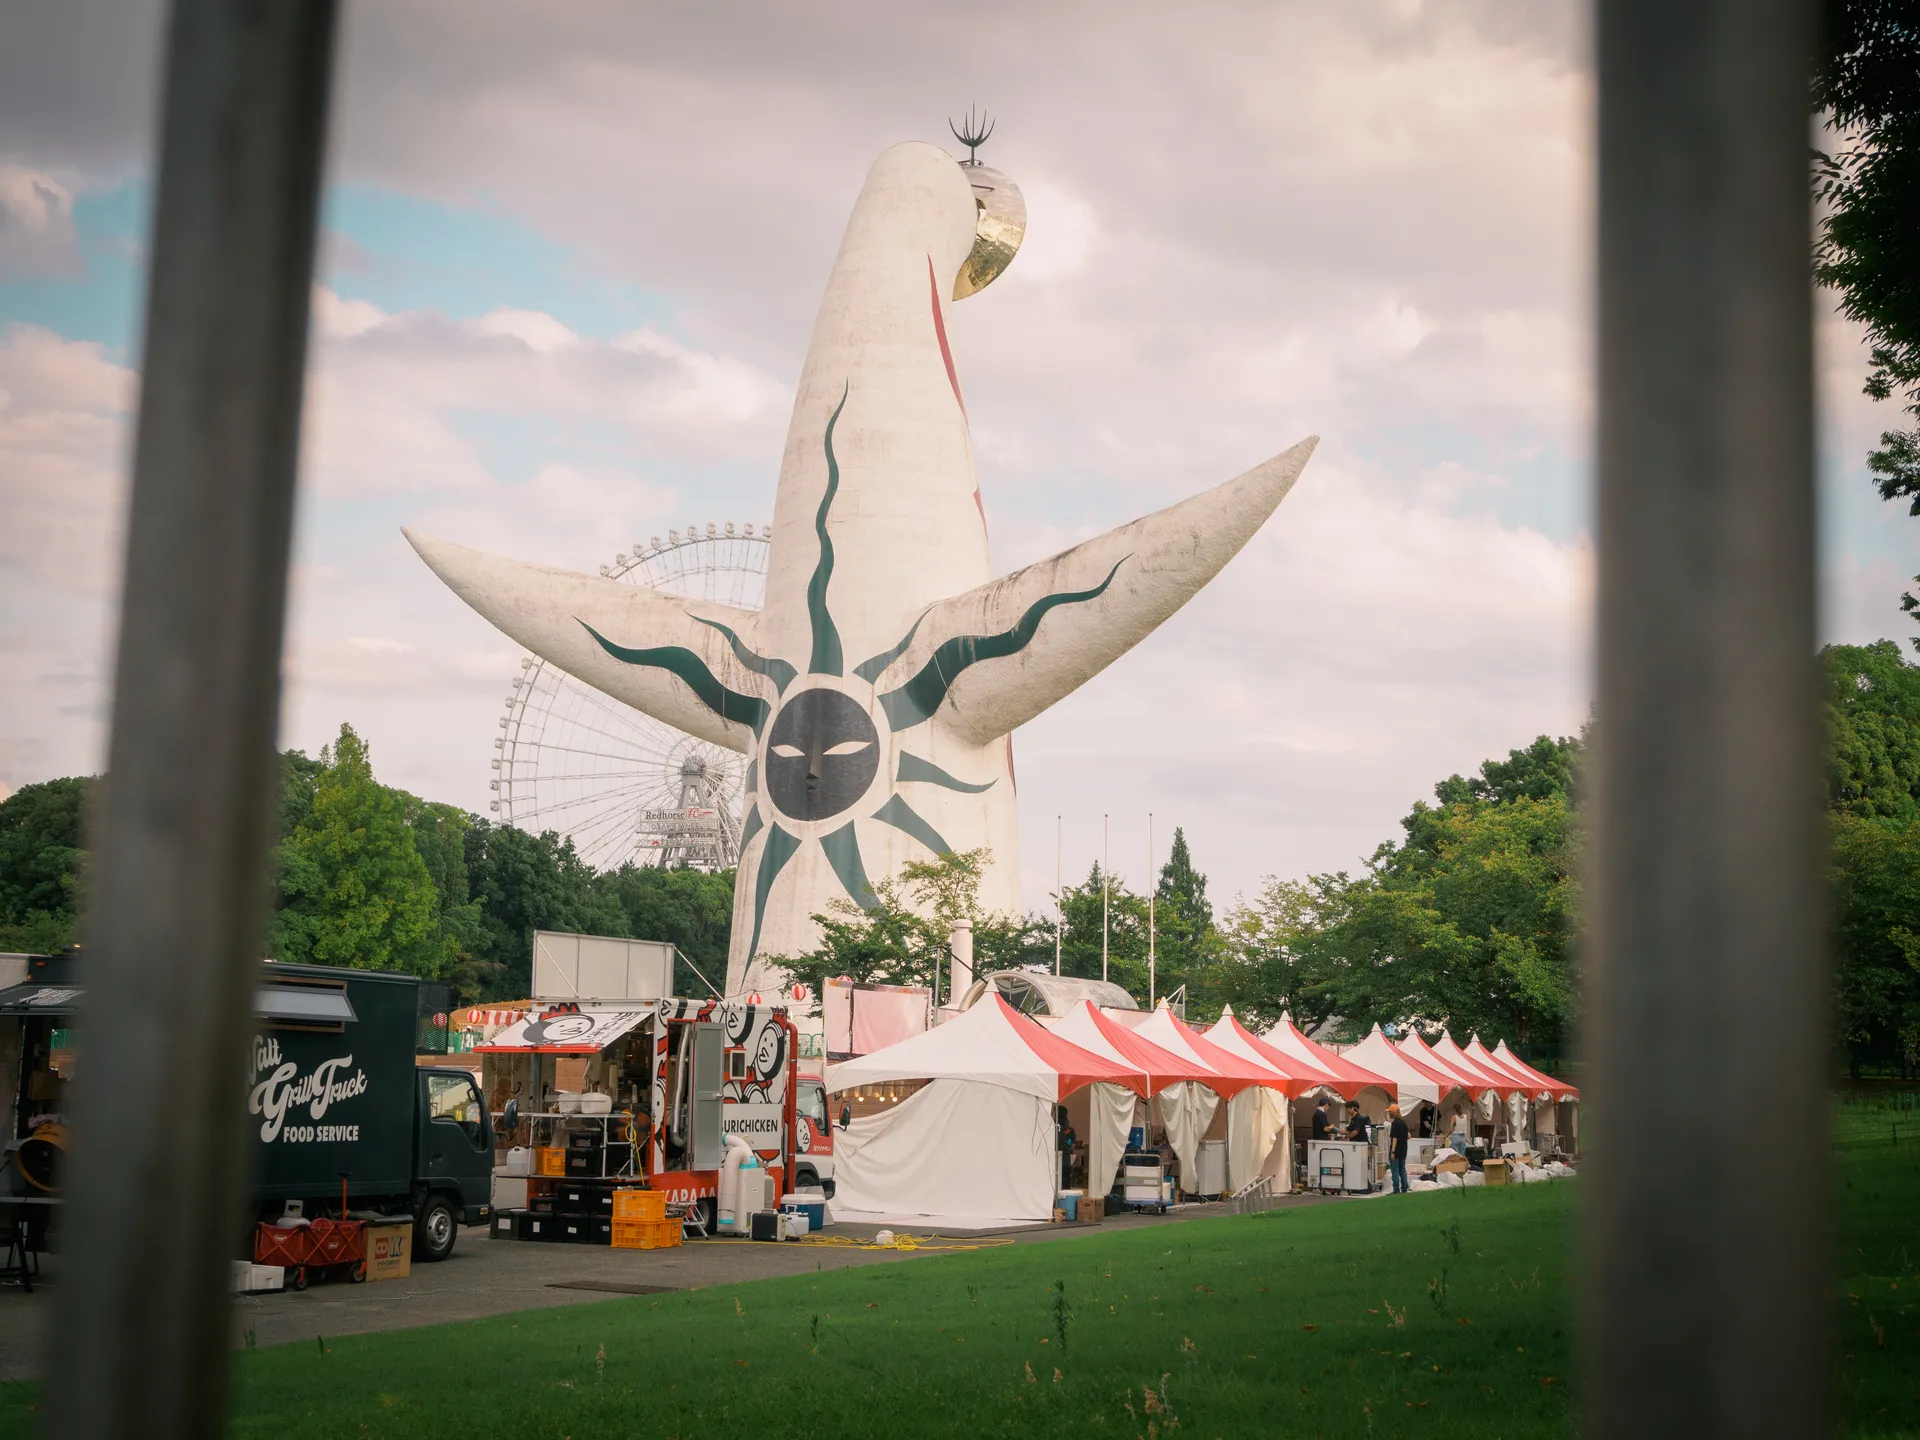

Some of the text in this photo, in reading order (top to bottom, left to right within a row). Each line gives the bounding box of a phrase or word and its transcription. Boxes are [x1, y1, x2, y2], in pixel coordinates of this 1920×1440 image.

[645, 810, 685, 820] Redhorse
[248, 1053, 368, 1143] Grill Truck
[722, 1118, 778, 1133] URICHICKEN
[283, 1125, 359, 1143] FOOD SERVICE
